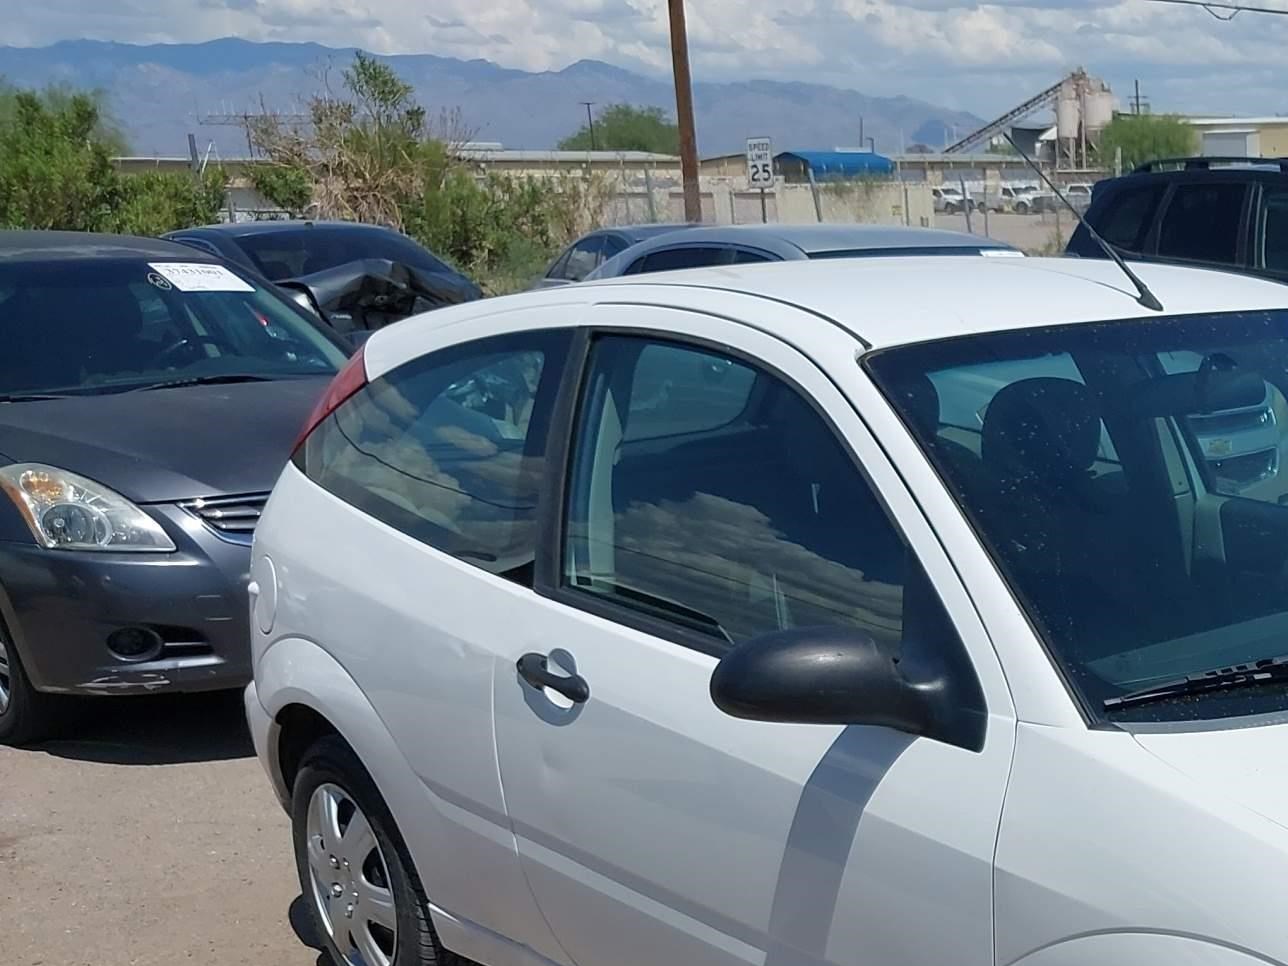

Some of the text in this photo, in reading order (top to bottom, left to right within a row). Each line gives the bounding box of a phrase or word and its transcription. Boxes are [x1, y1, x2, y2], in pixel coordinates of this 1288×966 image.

[748, 143, 769, 152] SPEED
[751, 152, 769, 162] LIMIT
[751, 164, 771, 182] 25
